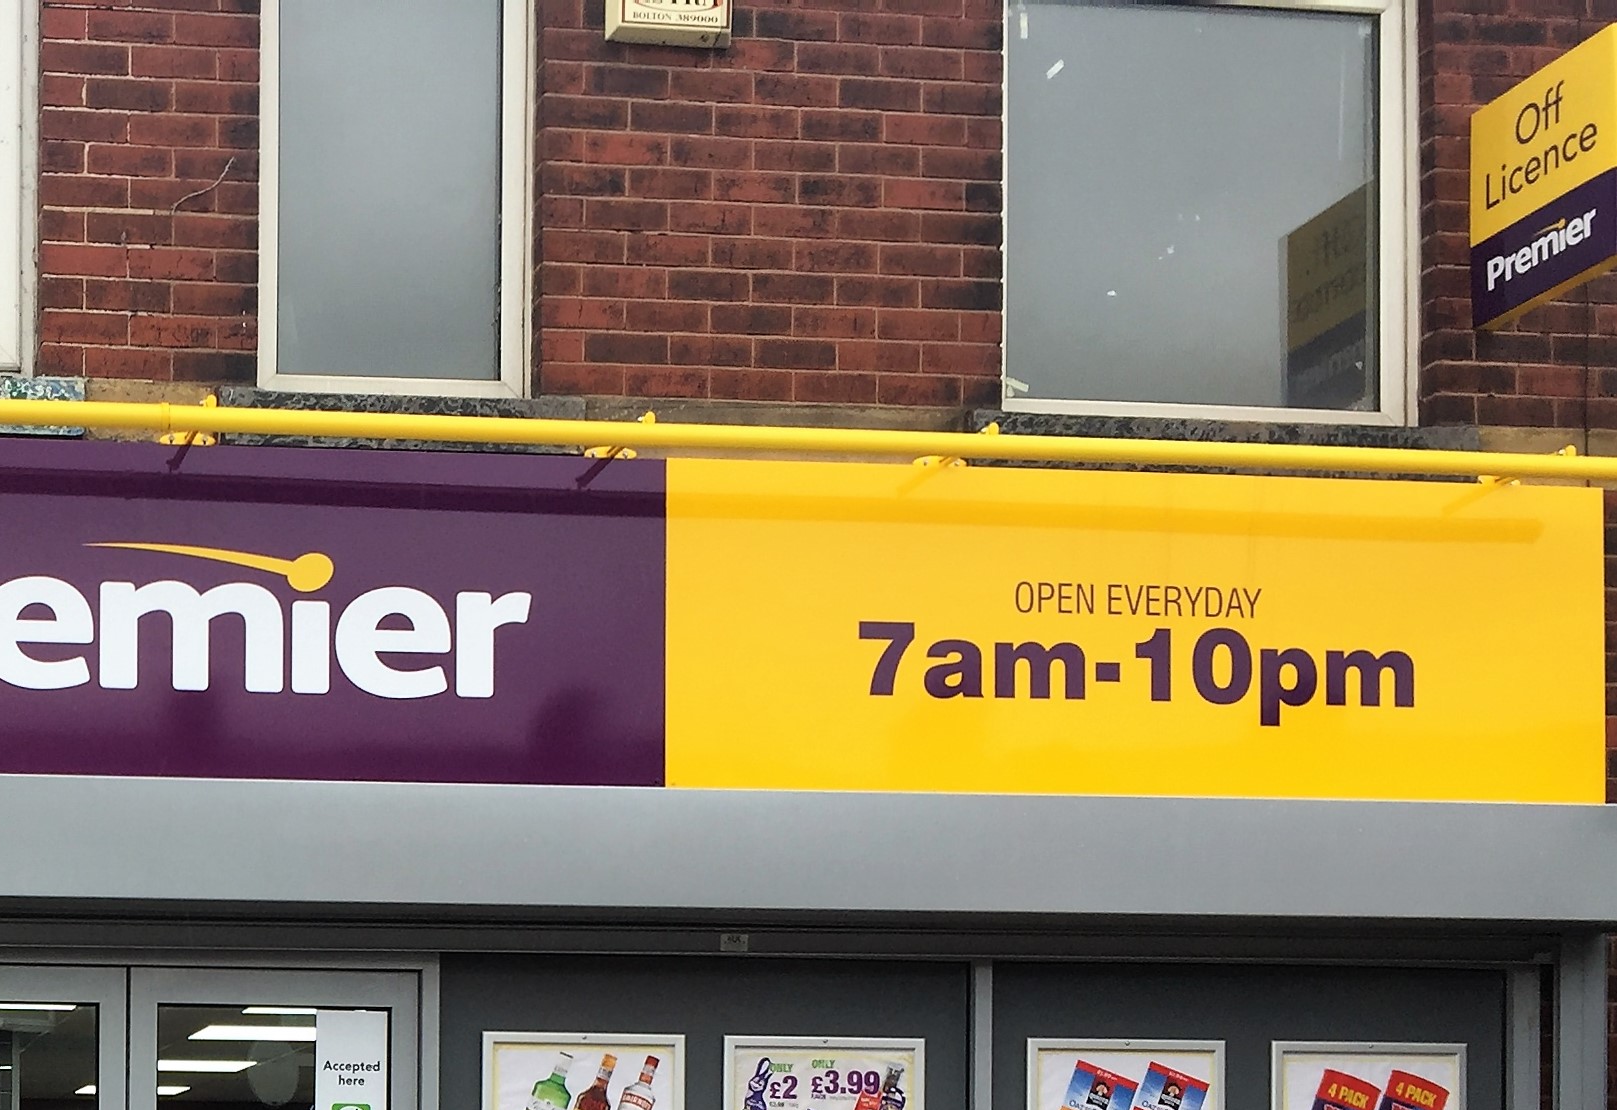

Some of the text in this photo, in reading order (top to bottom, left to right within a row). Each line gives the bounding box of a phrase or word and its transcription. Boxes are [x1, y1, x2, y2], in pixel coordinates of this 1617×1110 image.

[1516, 80, 1564, 144] Off
[1486, 122, 1597, 210] Licence
[1487, 208, 1596, 291] Premier
[1015, 581, 1262, 619] OPEN EVERYDAY
[858, 621, 1416, 726] 7am-10pm
[324, 1060, 380, 1074] Accepted
[770, 1064, 794, 1072] ONLY
[812, 1060, 836, 1068] ONLY
[338, 1075, 364, 1086] here
[770, 1076, 798, 1100] £2
[811, 1070, 880, 1094] £3.99
[1328, 1083, 1370, 1110] 4 PACK
[1396, 1082, 1438, 1108] 4 PACK
